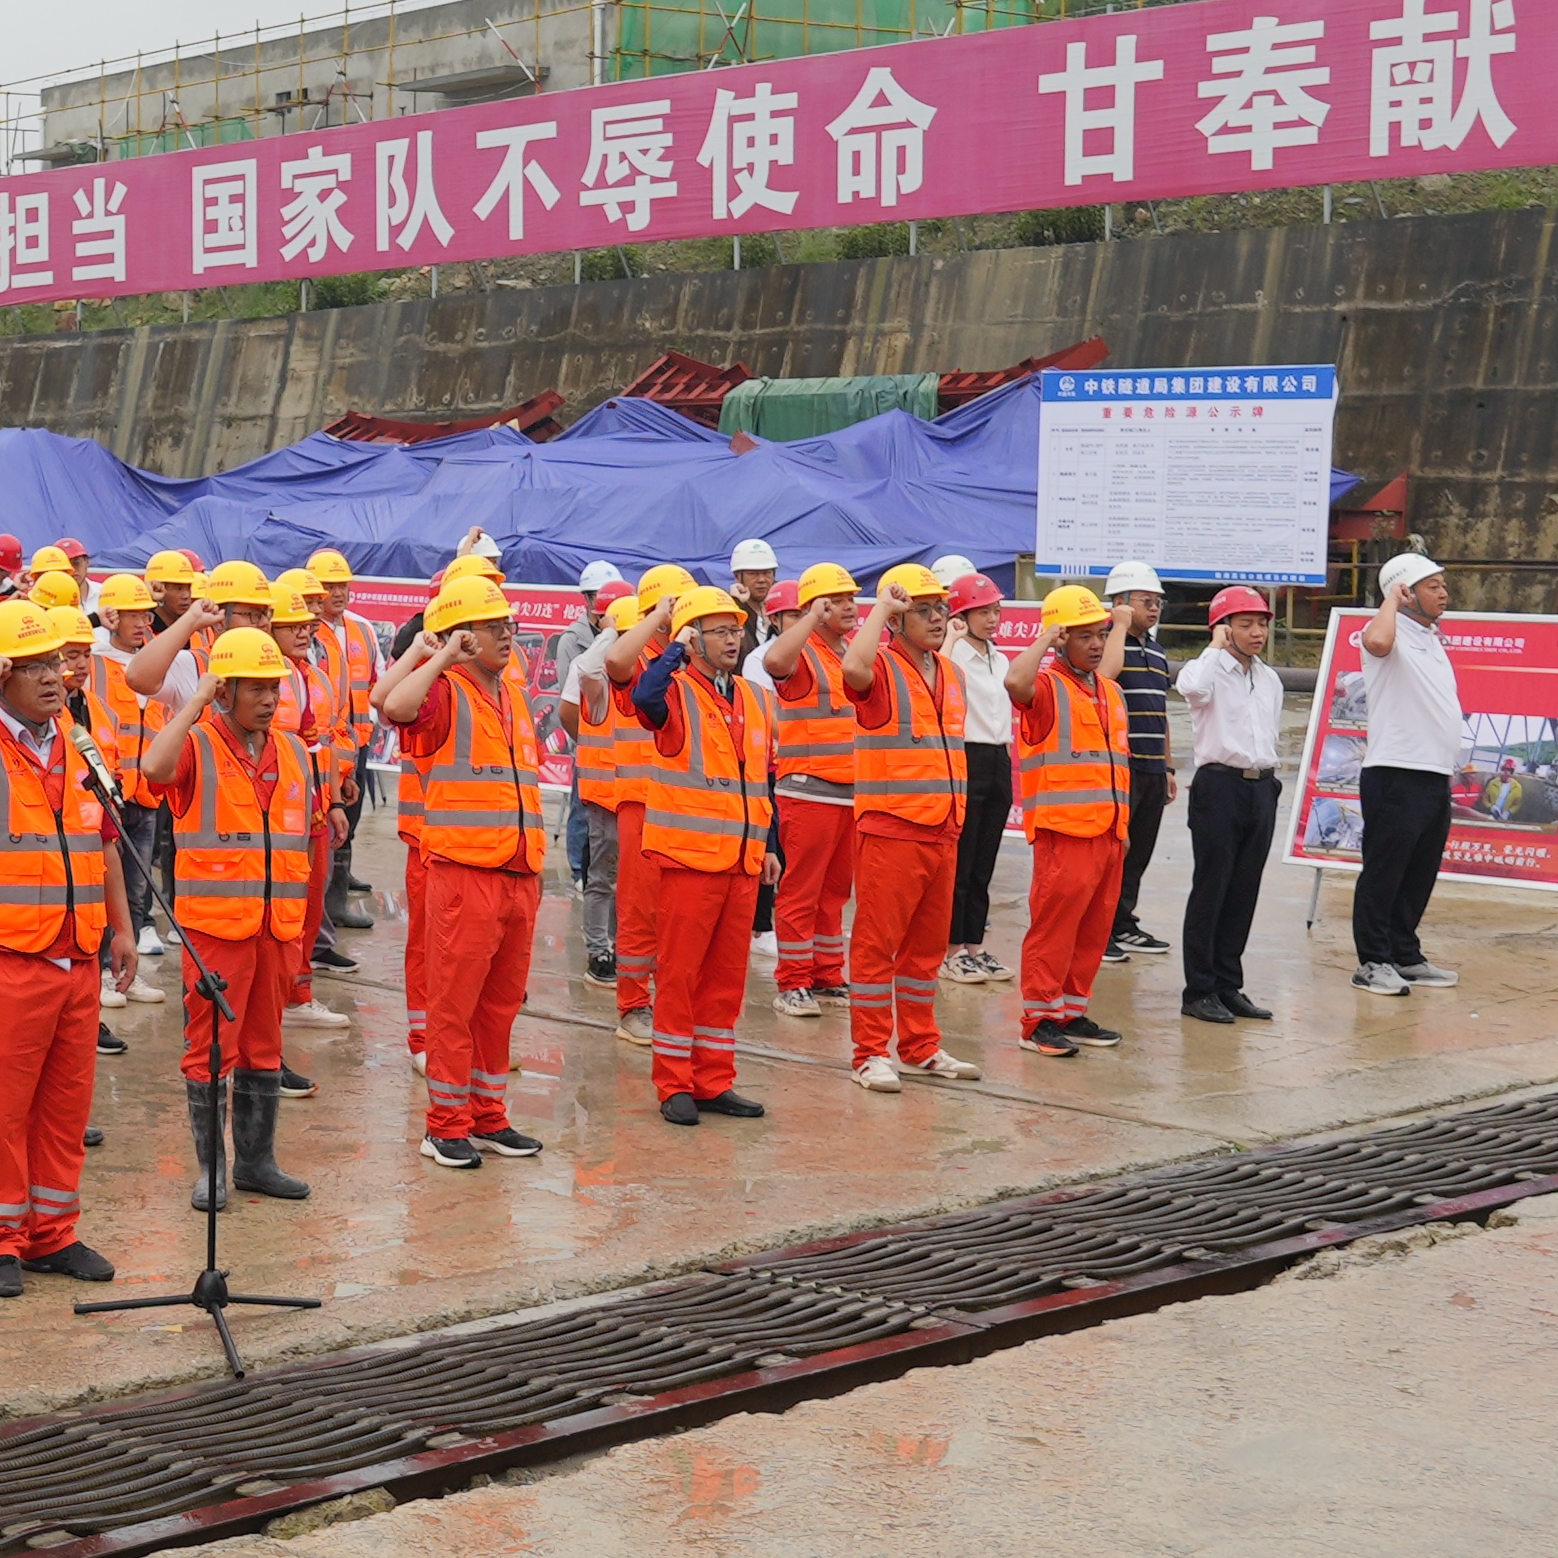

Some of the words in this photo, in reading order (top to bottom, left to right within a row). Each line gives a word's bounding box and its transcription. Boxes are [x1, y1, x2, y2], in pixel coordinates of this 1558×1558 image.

[191, 67, 939, 275] 国家队不辱使命
[1084, 375, 1318, 395] 中铁隧道局集团建设有限公司
